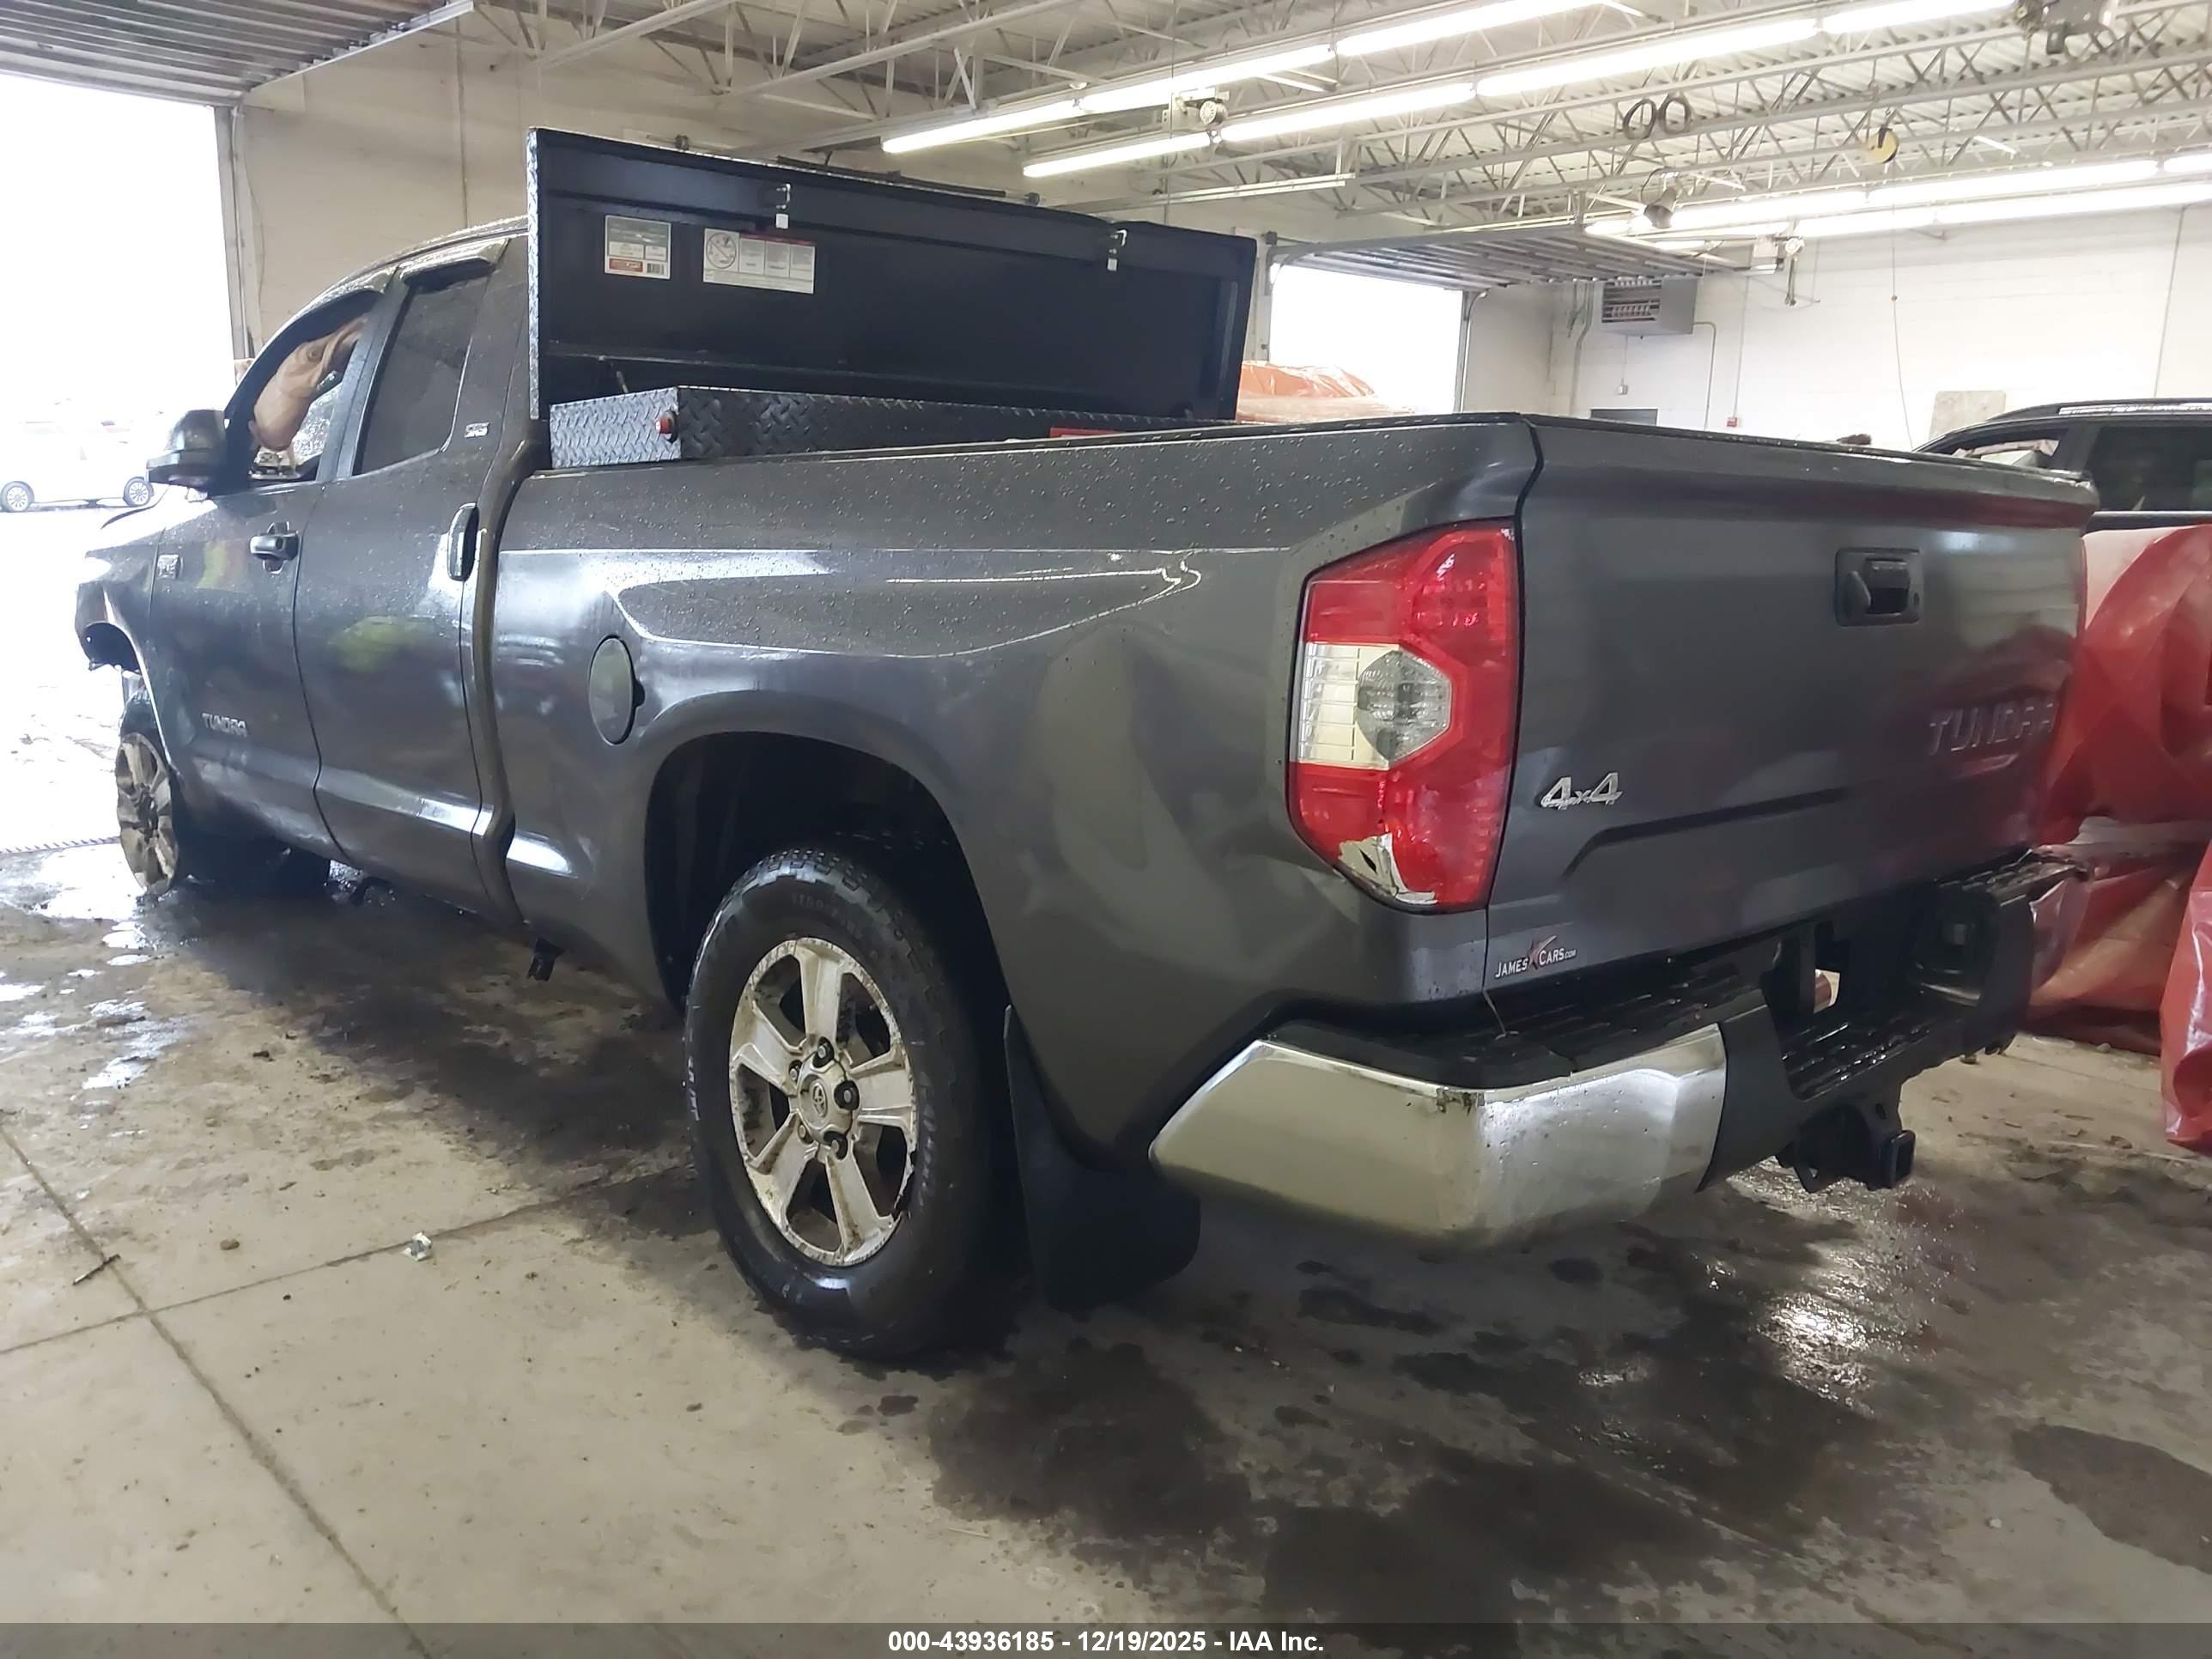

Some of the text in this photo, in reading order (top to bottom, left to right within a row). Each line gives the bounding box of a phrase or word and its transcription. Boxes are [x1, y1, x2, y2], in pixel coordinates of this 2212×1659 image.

[201, 712, 248, 738] TUNDRA
[1929, 700, 2058, 757] TUNDRA
[1540, 771, 1623, 811] 4x4
[1495, 957, 1529, 978] JAMES
